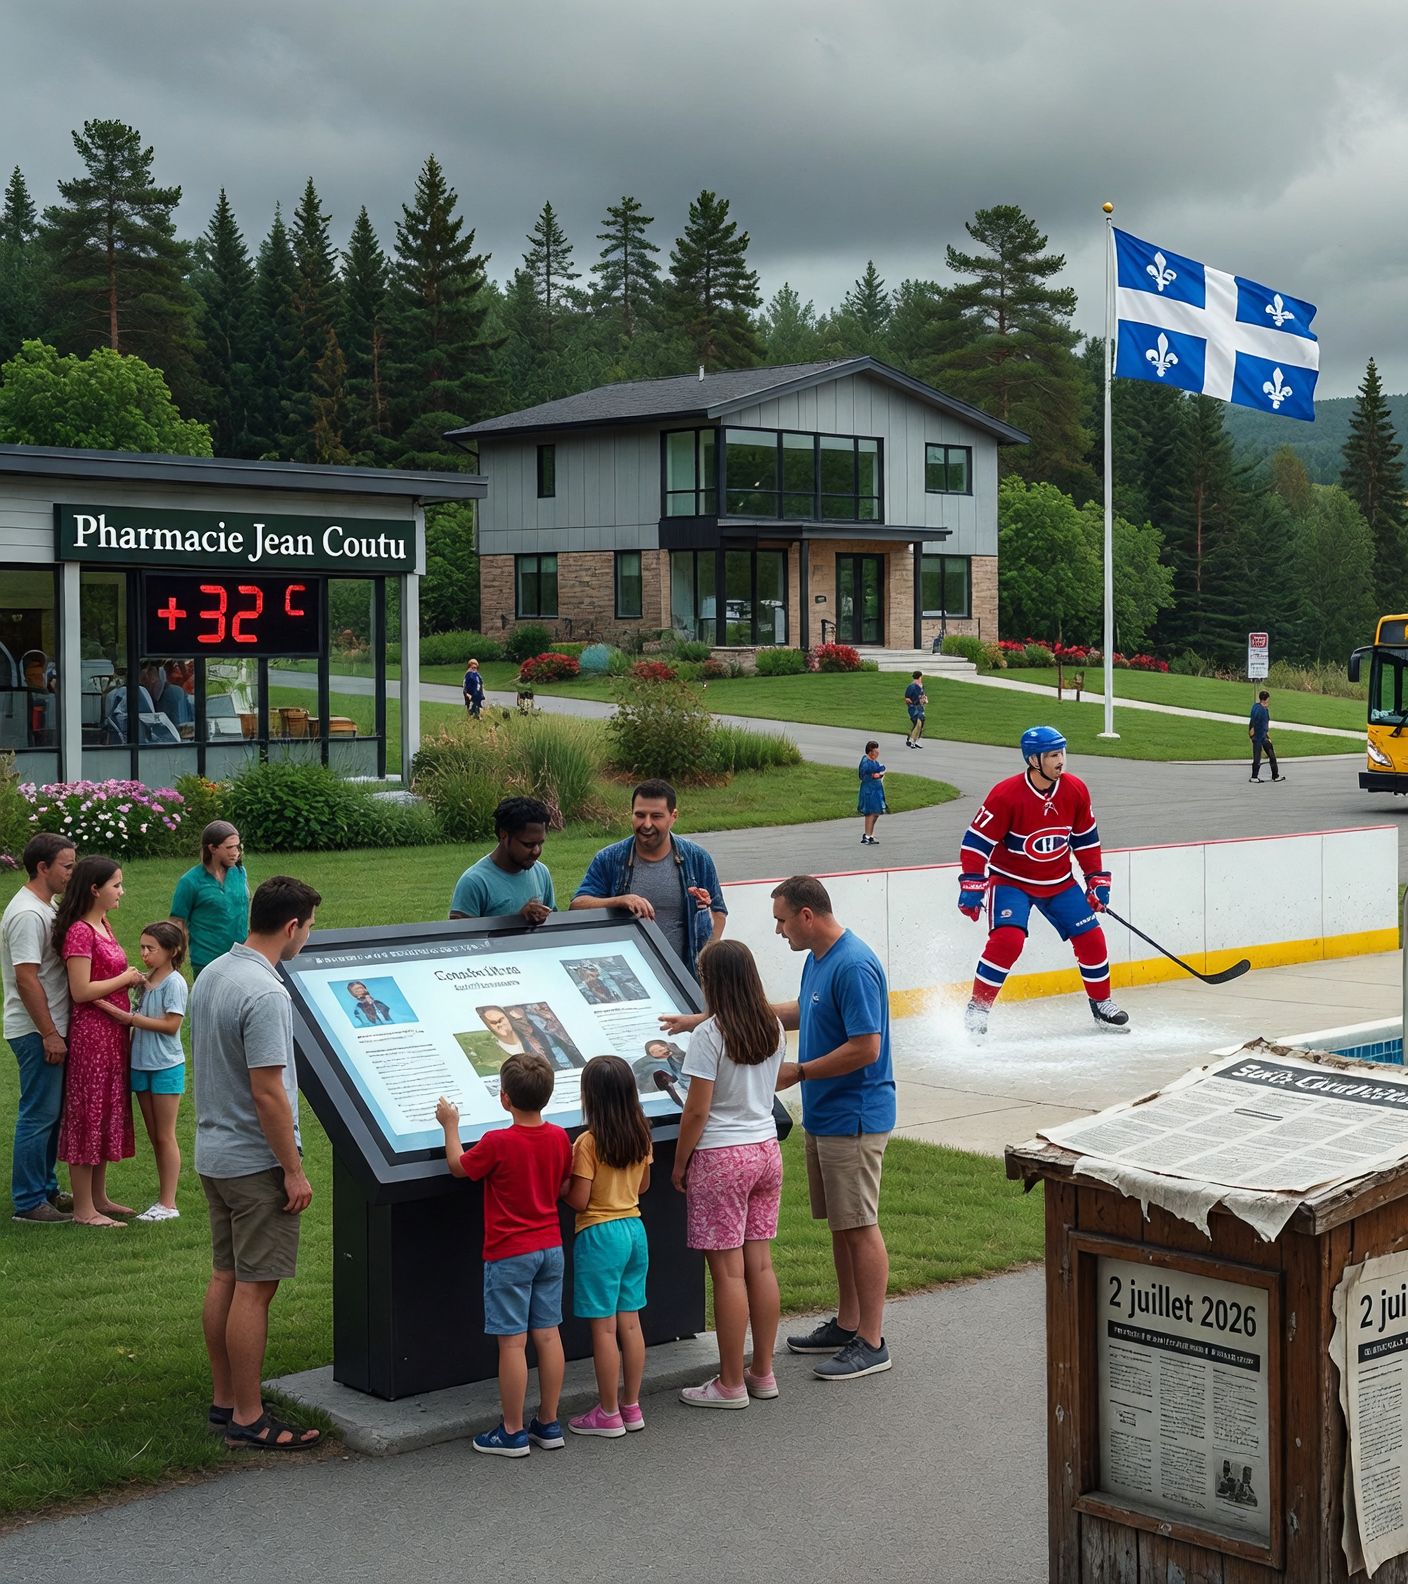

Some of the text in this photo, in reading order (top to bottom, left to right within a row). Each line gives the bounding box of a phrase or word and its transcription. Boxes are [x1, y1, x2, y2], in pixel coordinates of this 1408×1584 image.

[73, 514, 407, 562] Pharmacie Jean Coutu
[284, 584, 306, 617] C
[1109, 1276, 1257, 1337] 2 juillet 2026
[1360, 1294, 1373, 1329] 2
